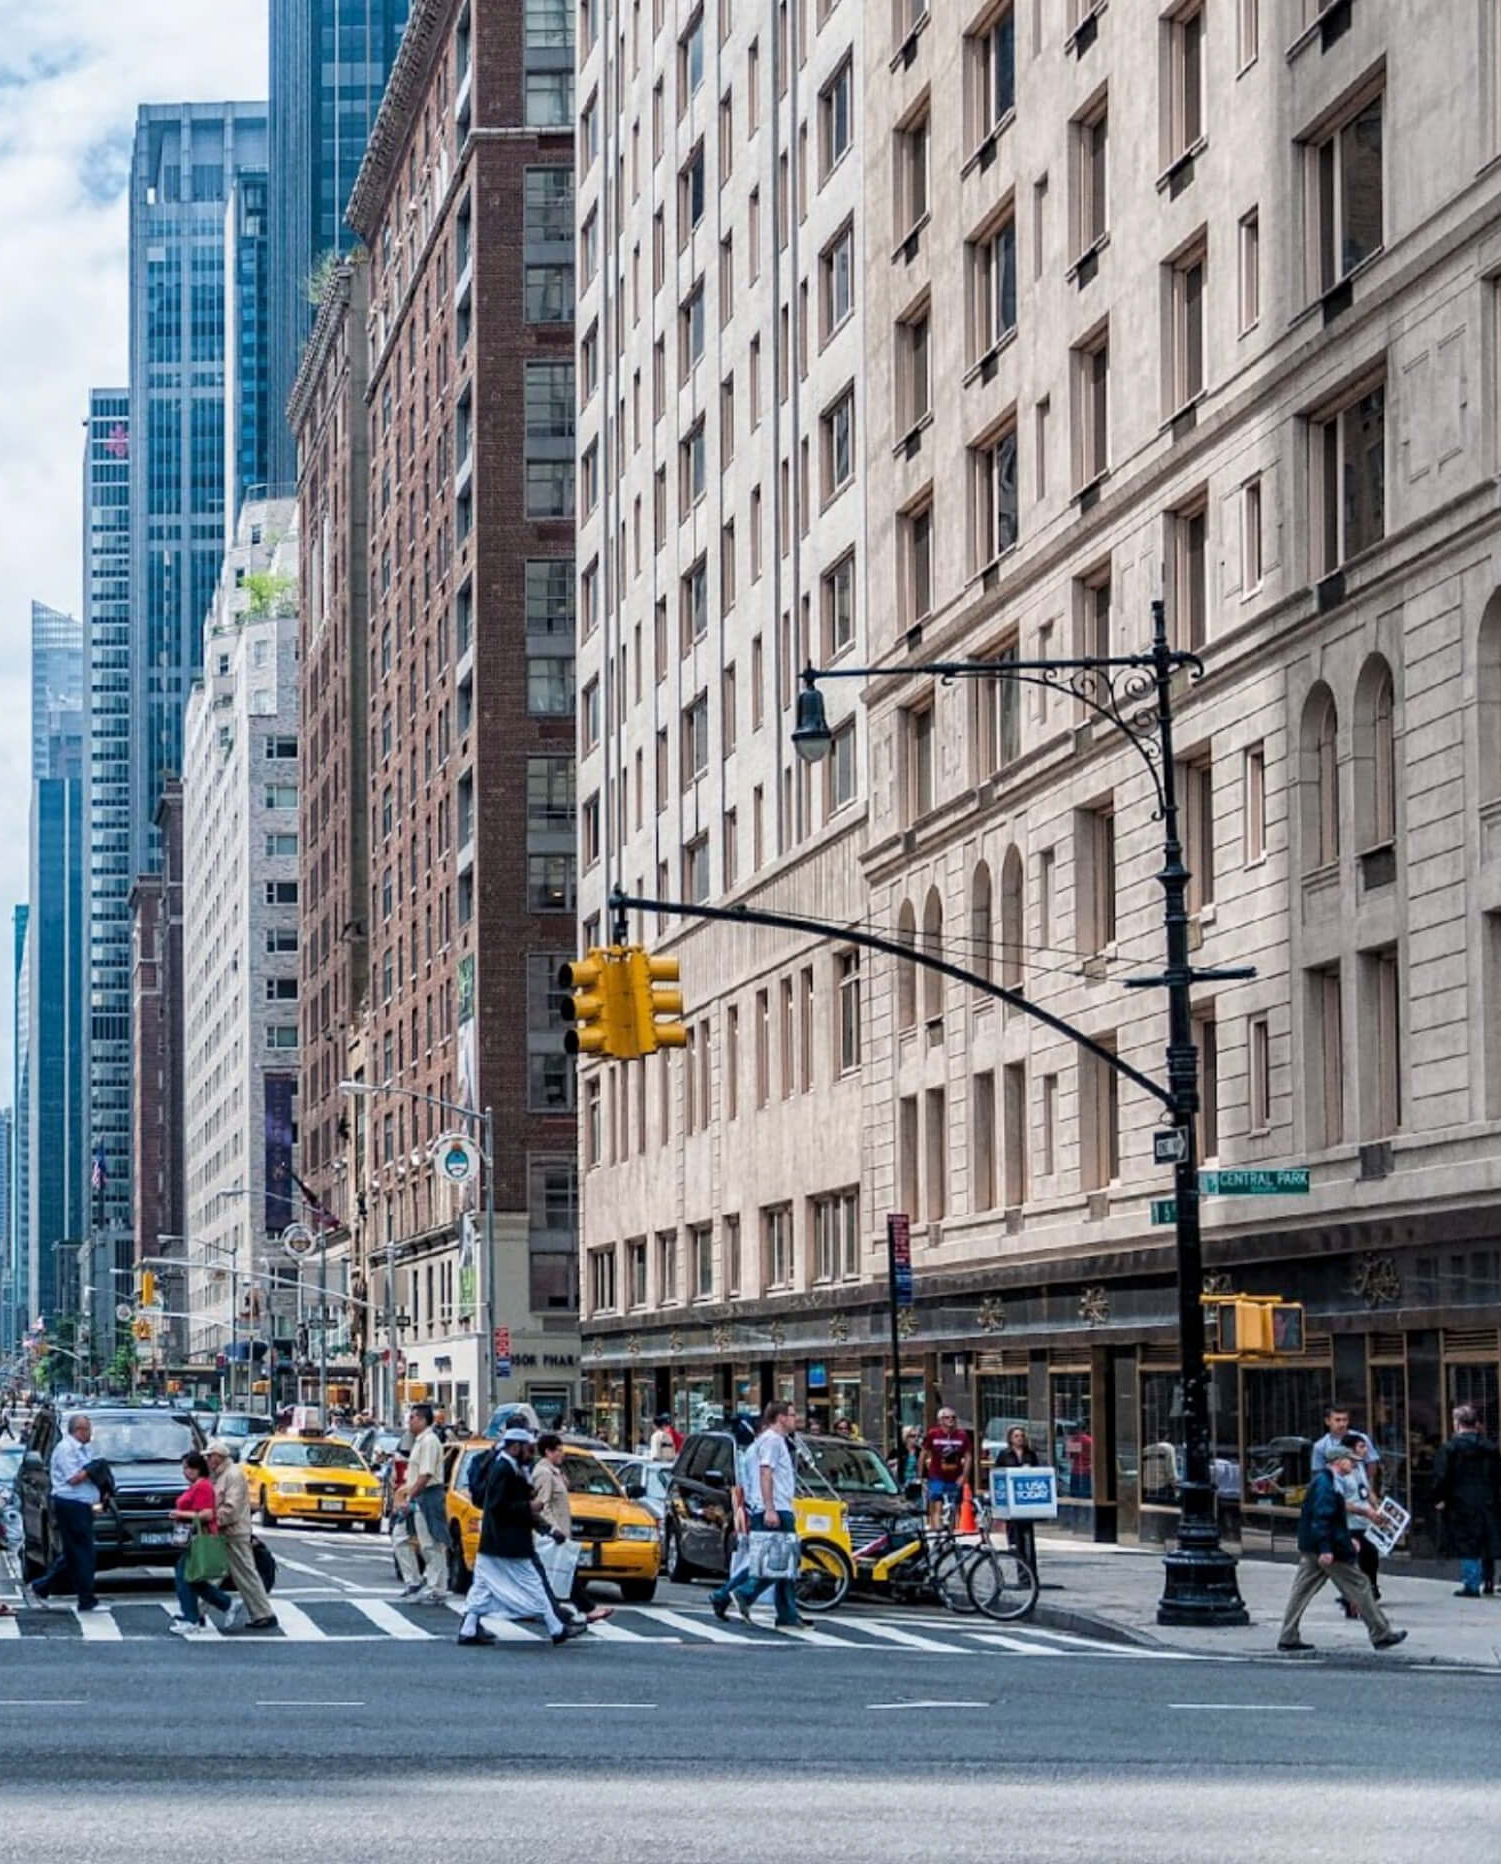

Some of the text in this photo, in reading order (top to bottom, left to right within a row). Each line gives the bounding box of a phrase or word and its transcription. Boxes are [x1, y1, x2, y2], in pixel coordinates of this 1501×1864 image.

[1220, 1172, 1273, 1186] CENTRAL
[1277, 1171, 1308, 1185] PARK
[1026, 1481, 1048, 1491] USA
[1016, 1489, 1049, 1500] TODAY
